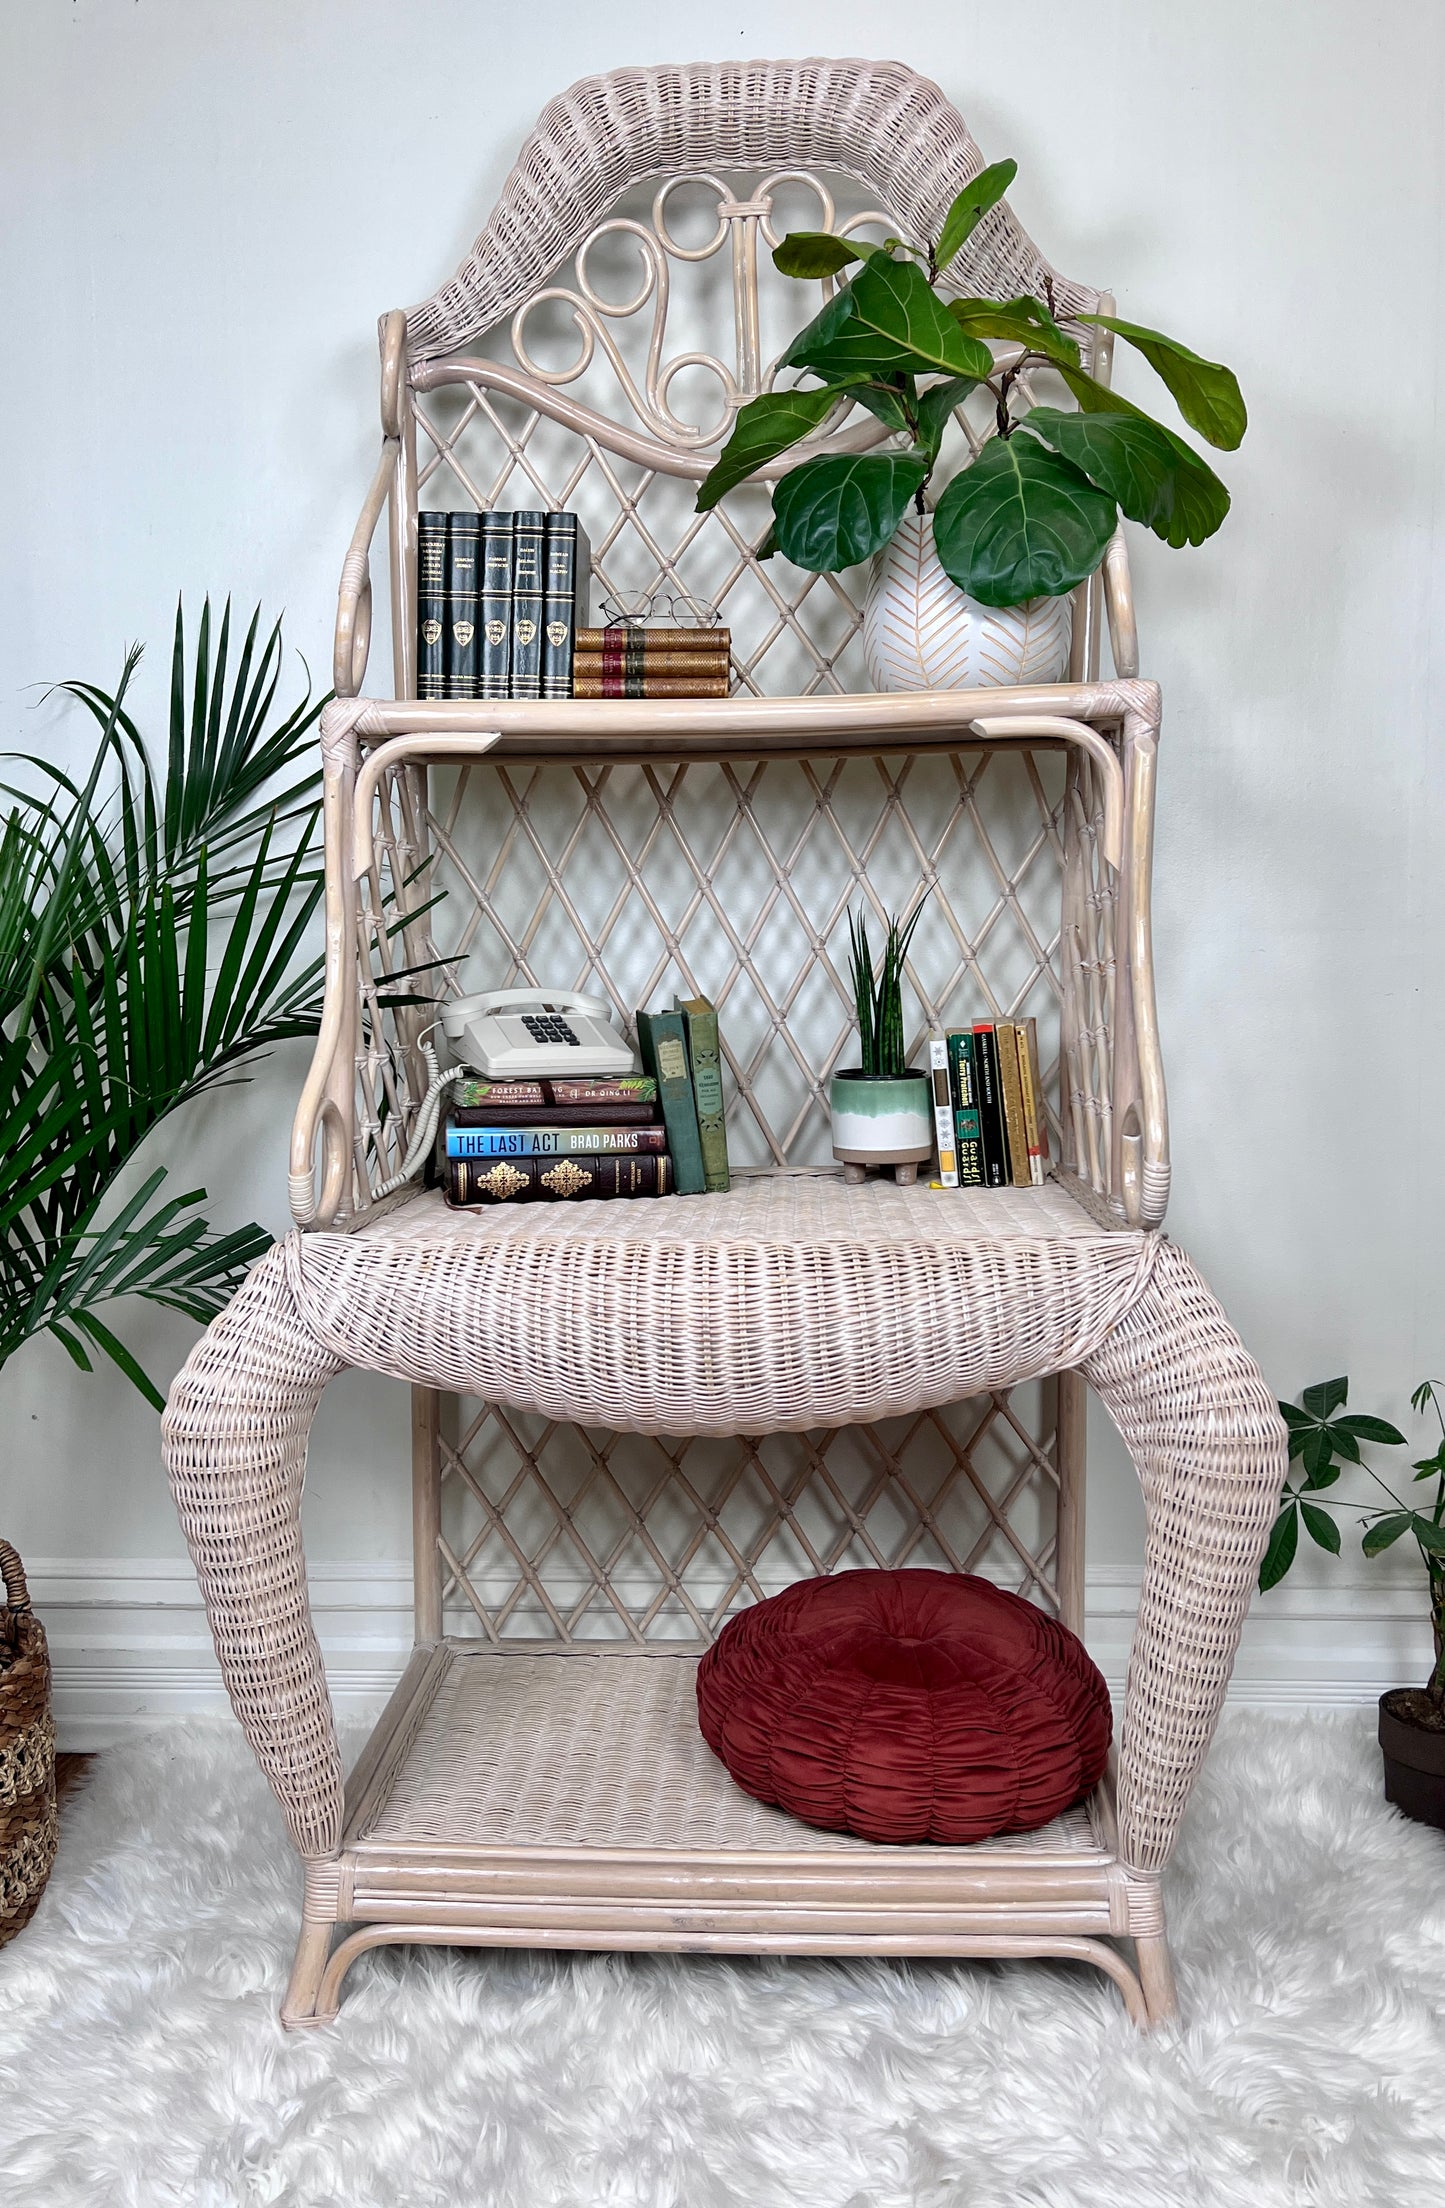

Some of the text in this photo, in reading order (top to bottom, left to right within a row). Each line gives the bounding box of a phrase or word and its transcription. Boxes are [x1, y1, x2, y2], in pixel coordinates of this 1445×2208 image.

[959, 1059, 968, 1076] Terry
[526, 1086, 563, 1094] BATNG
[960, 1077, 970, 1107] Pratchett
[456, 1133, 561, 1153] THE LAST ACT
[570, 1133, 638, 1149] BRAD PARKS
[961, 1142, 973, 1183] Guards!
[970, 1141, 981, 1183] Guards!
